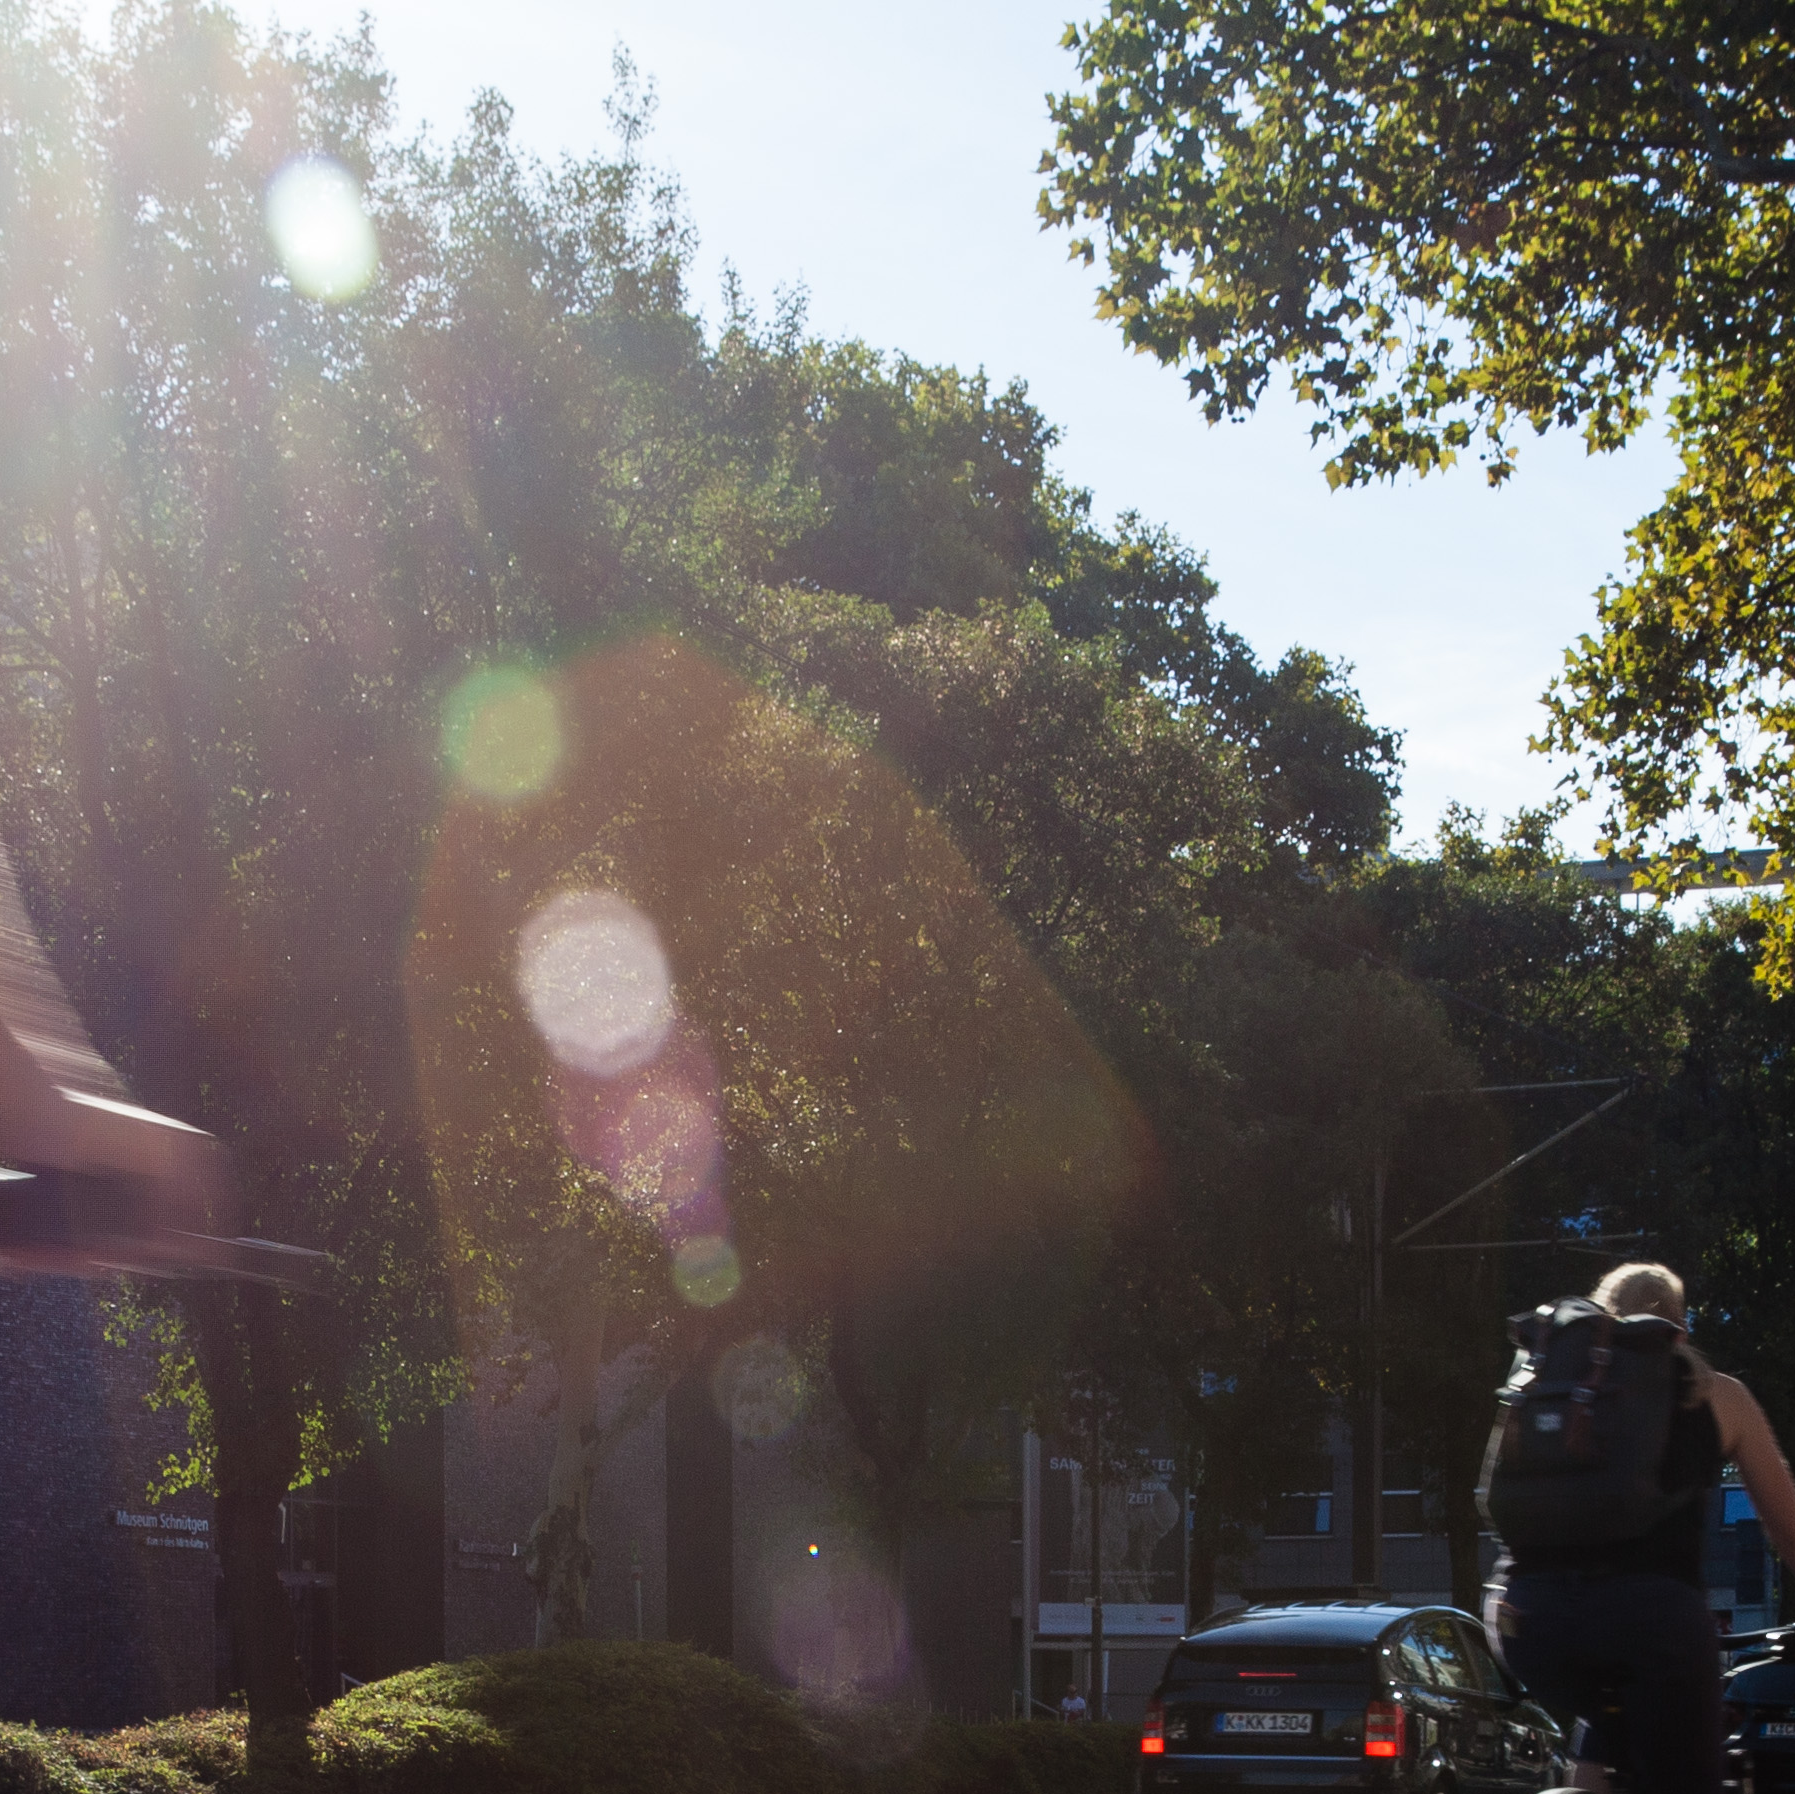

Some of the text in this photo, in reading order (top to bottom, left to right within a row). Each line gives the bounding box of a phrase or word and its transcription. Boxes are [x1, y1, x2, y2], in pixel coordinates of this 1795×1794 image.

[1128, 1493, 1156, 1505] ZEIT
[116, 1510, 209, 1535] Museum Schnütgen
[1225, 1715, 1235, 1729] K
[1269, 1715, 1309, 1730] 1304
